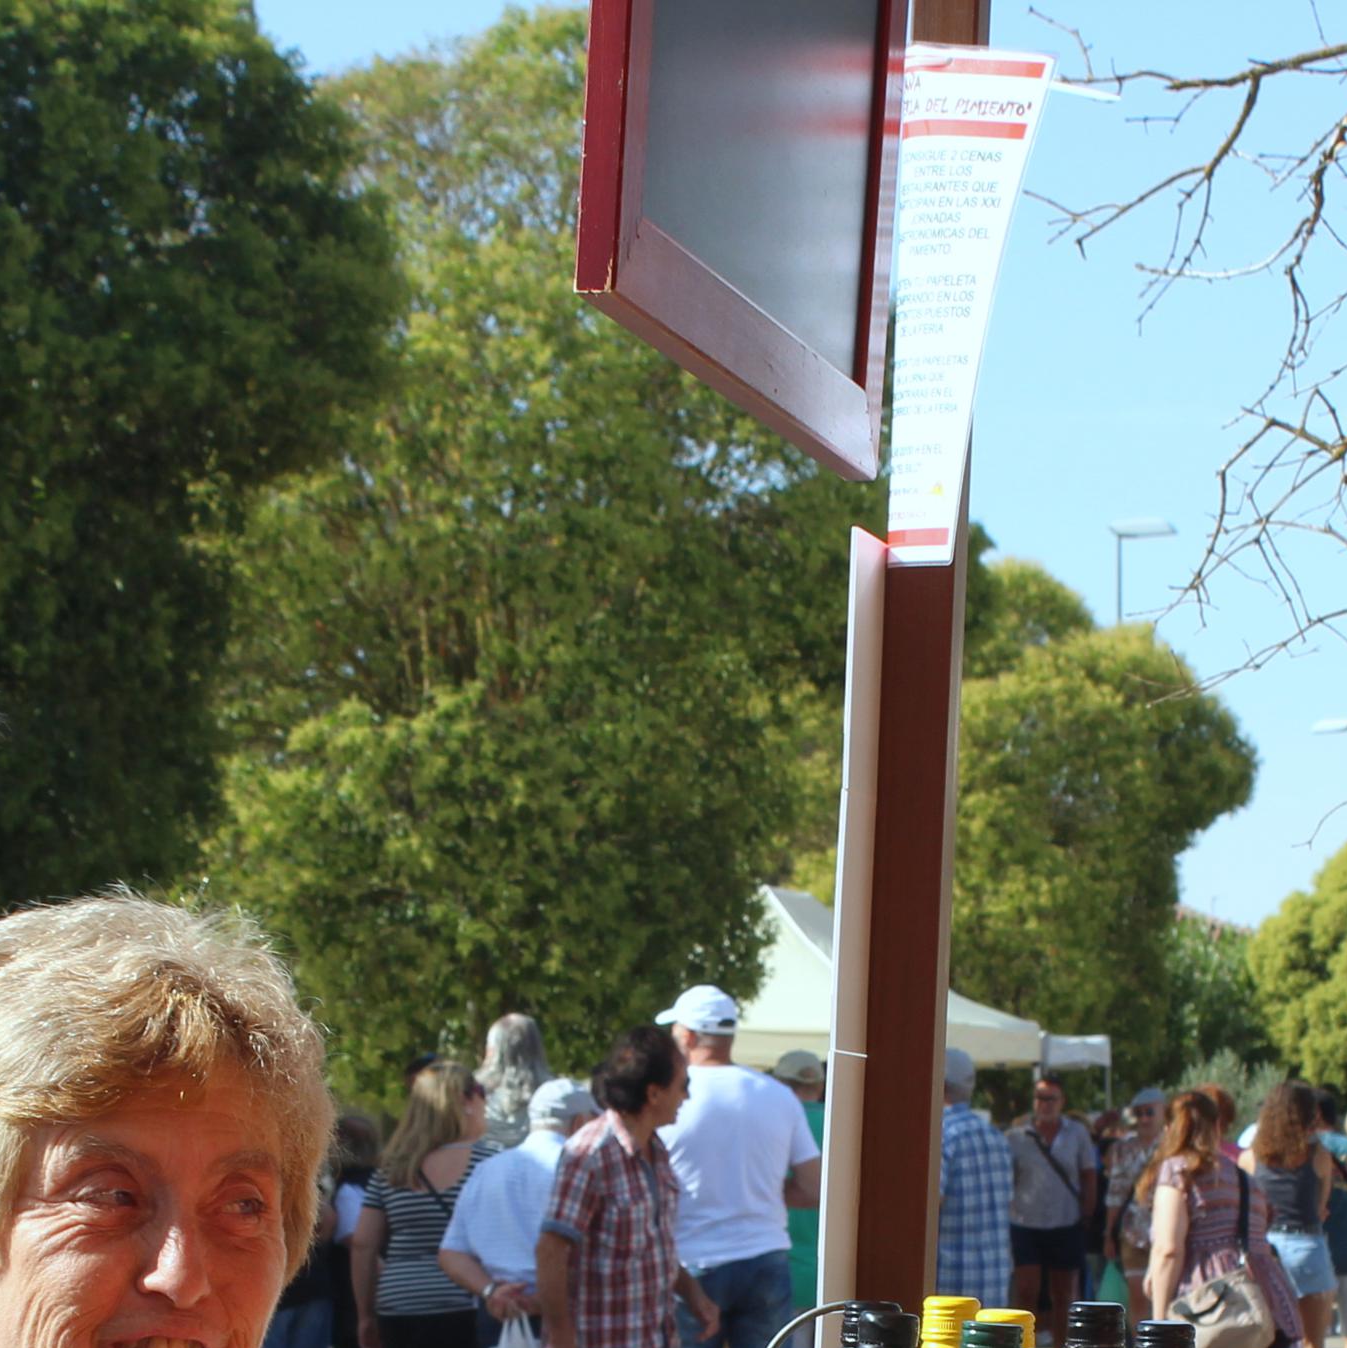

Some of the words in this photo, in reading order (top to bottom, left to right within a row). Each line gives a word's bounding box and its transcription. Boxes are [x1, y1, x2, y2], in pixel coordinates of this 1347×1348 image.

[926, 96, 949, 113] DEL
[960, 150, 1003, 162] CENAS
[949, 164, 972, 176] LOS
[972, 181, 999, 193] QUE
[938, 196, 954, 208] EN
[956, 196, 978, 208] LAS
[968, 227, 989, 239] DEL
[953, 290, 975, 302] LOS
